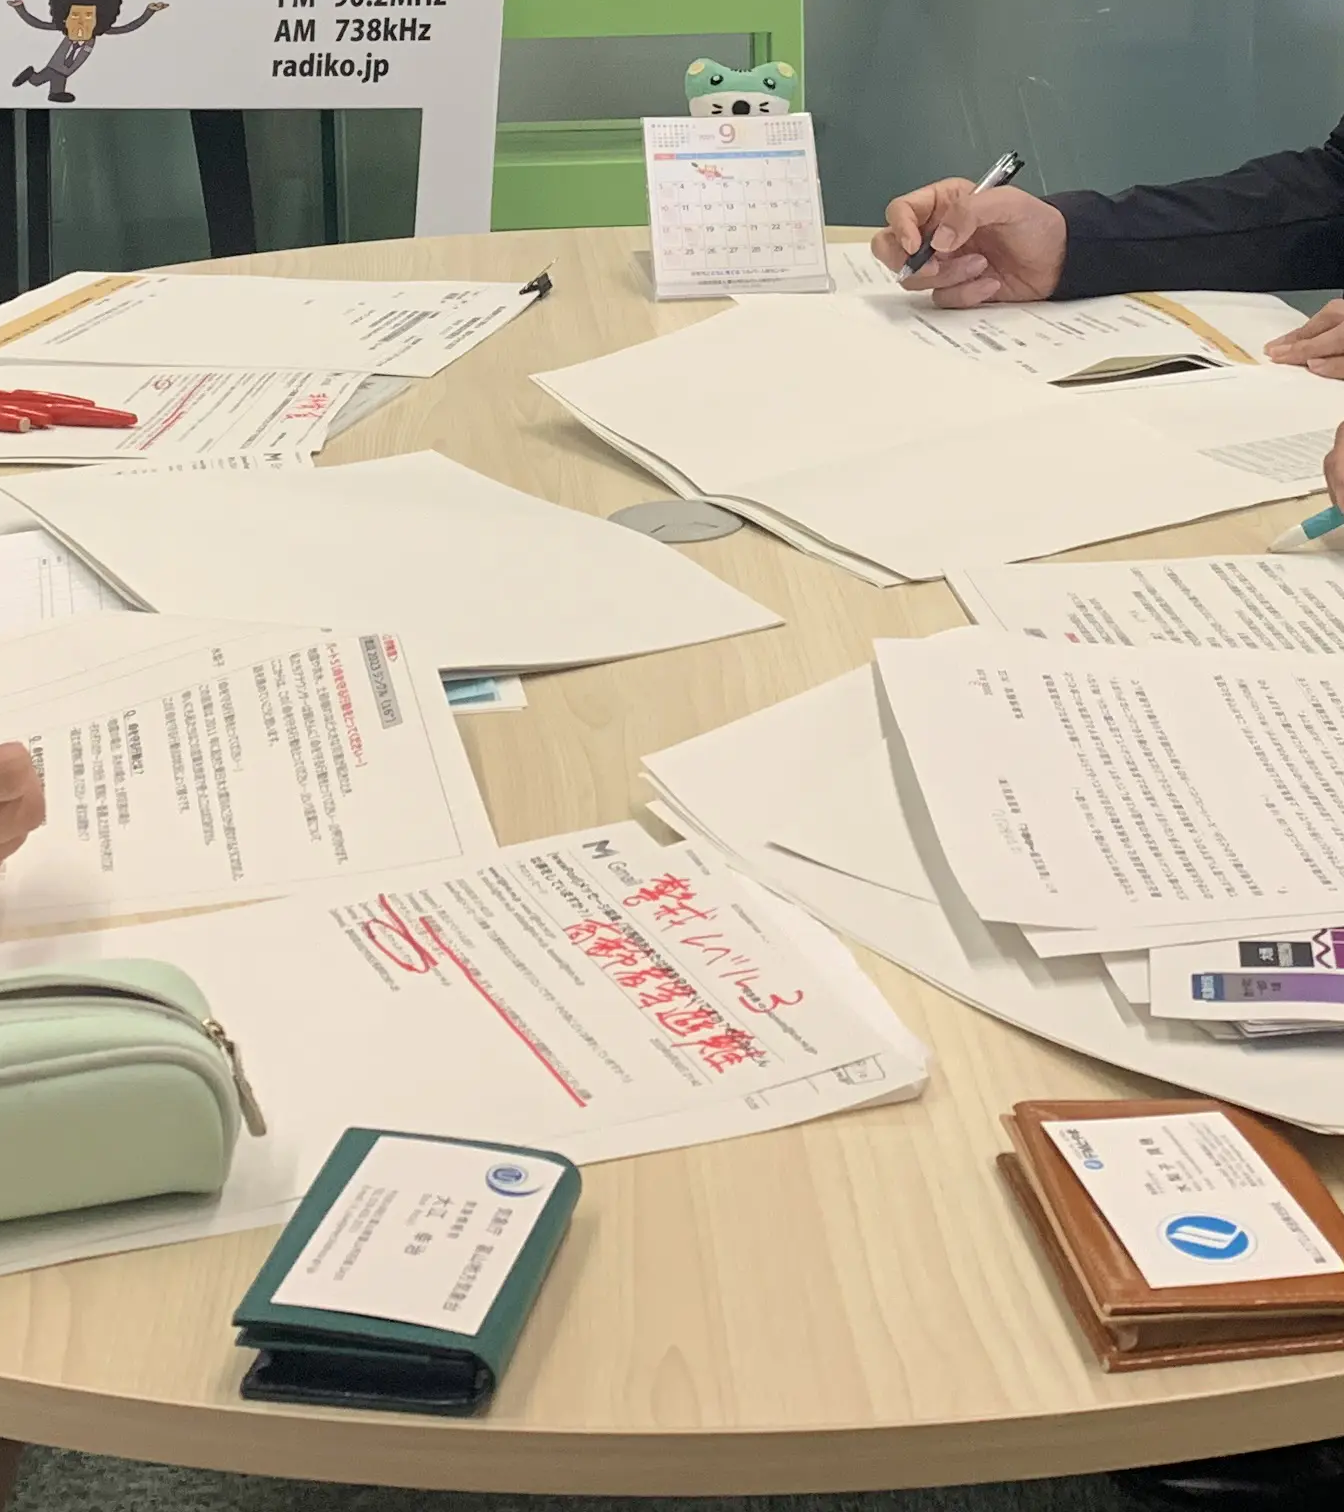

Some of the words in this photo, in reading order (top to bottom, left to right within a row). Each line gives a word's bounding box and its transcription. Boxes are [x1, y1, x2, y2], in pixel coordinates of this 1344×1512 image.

[275, 20, 316, 43] AM
[334, 17, 432, 42] 738kHz
[272, 52, 389, 84] radiko.jp
[719, 123, 736, 144] 9
